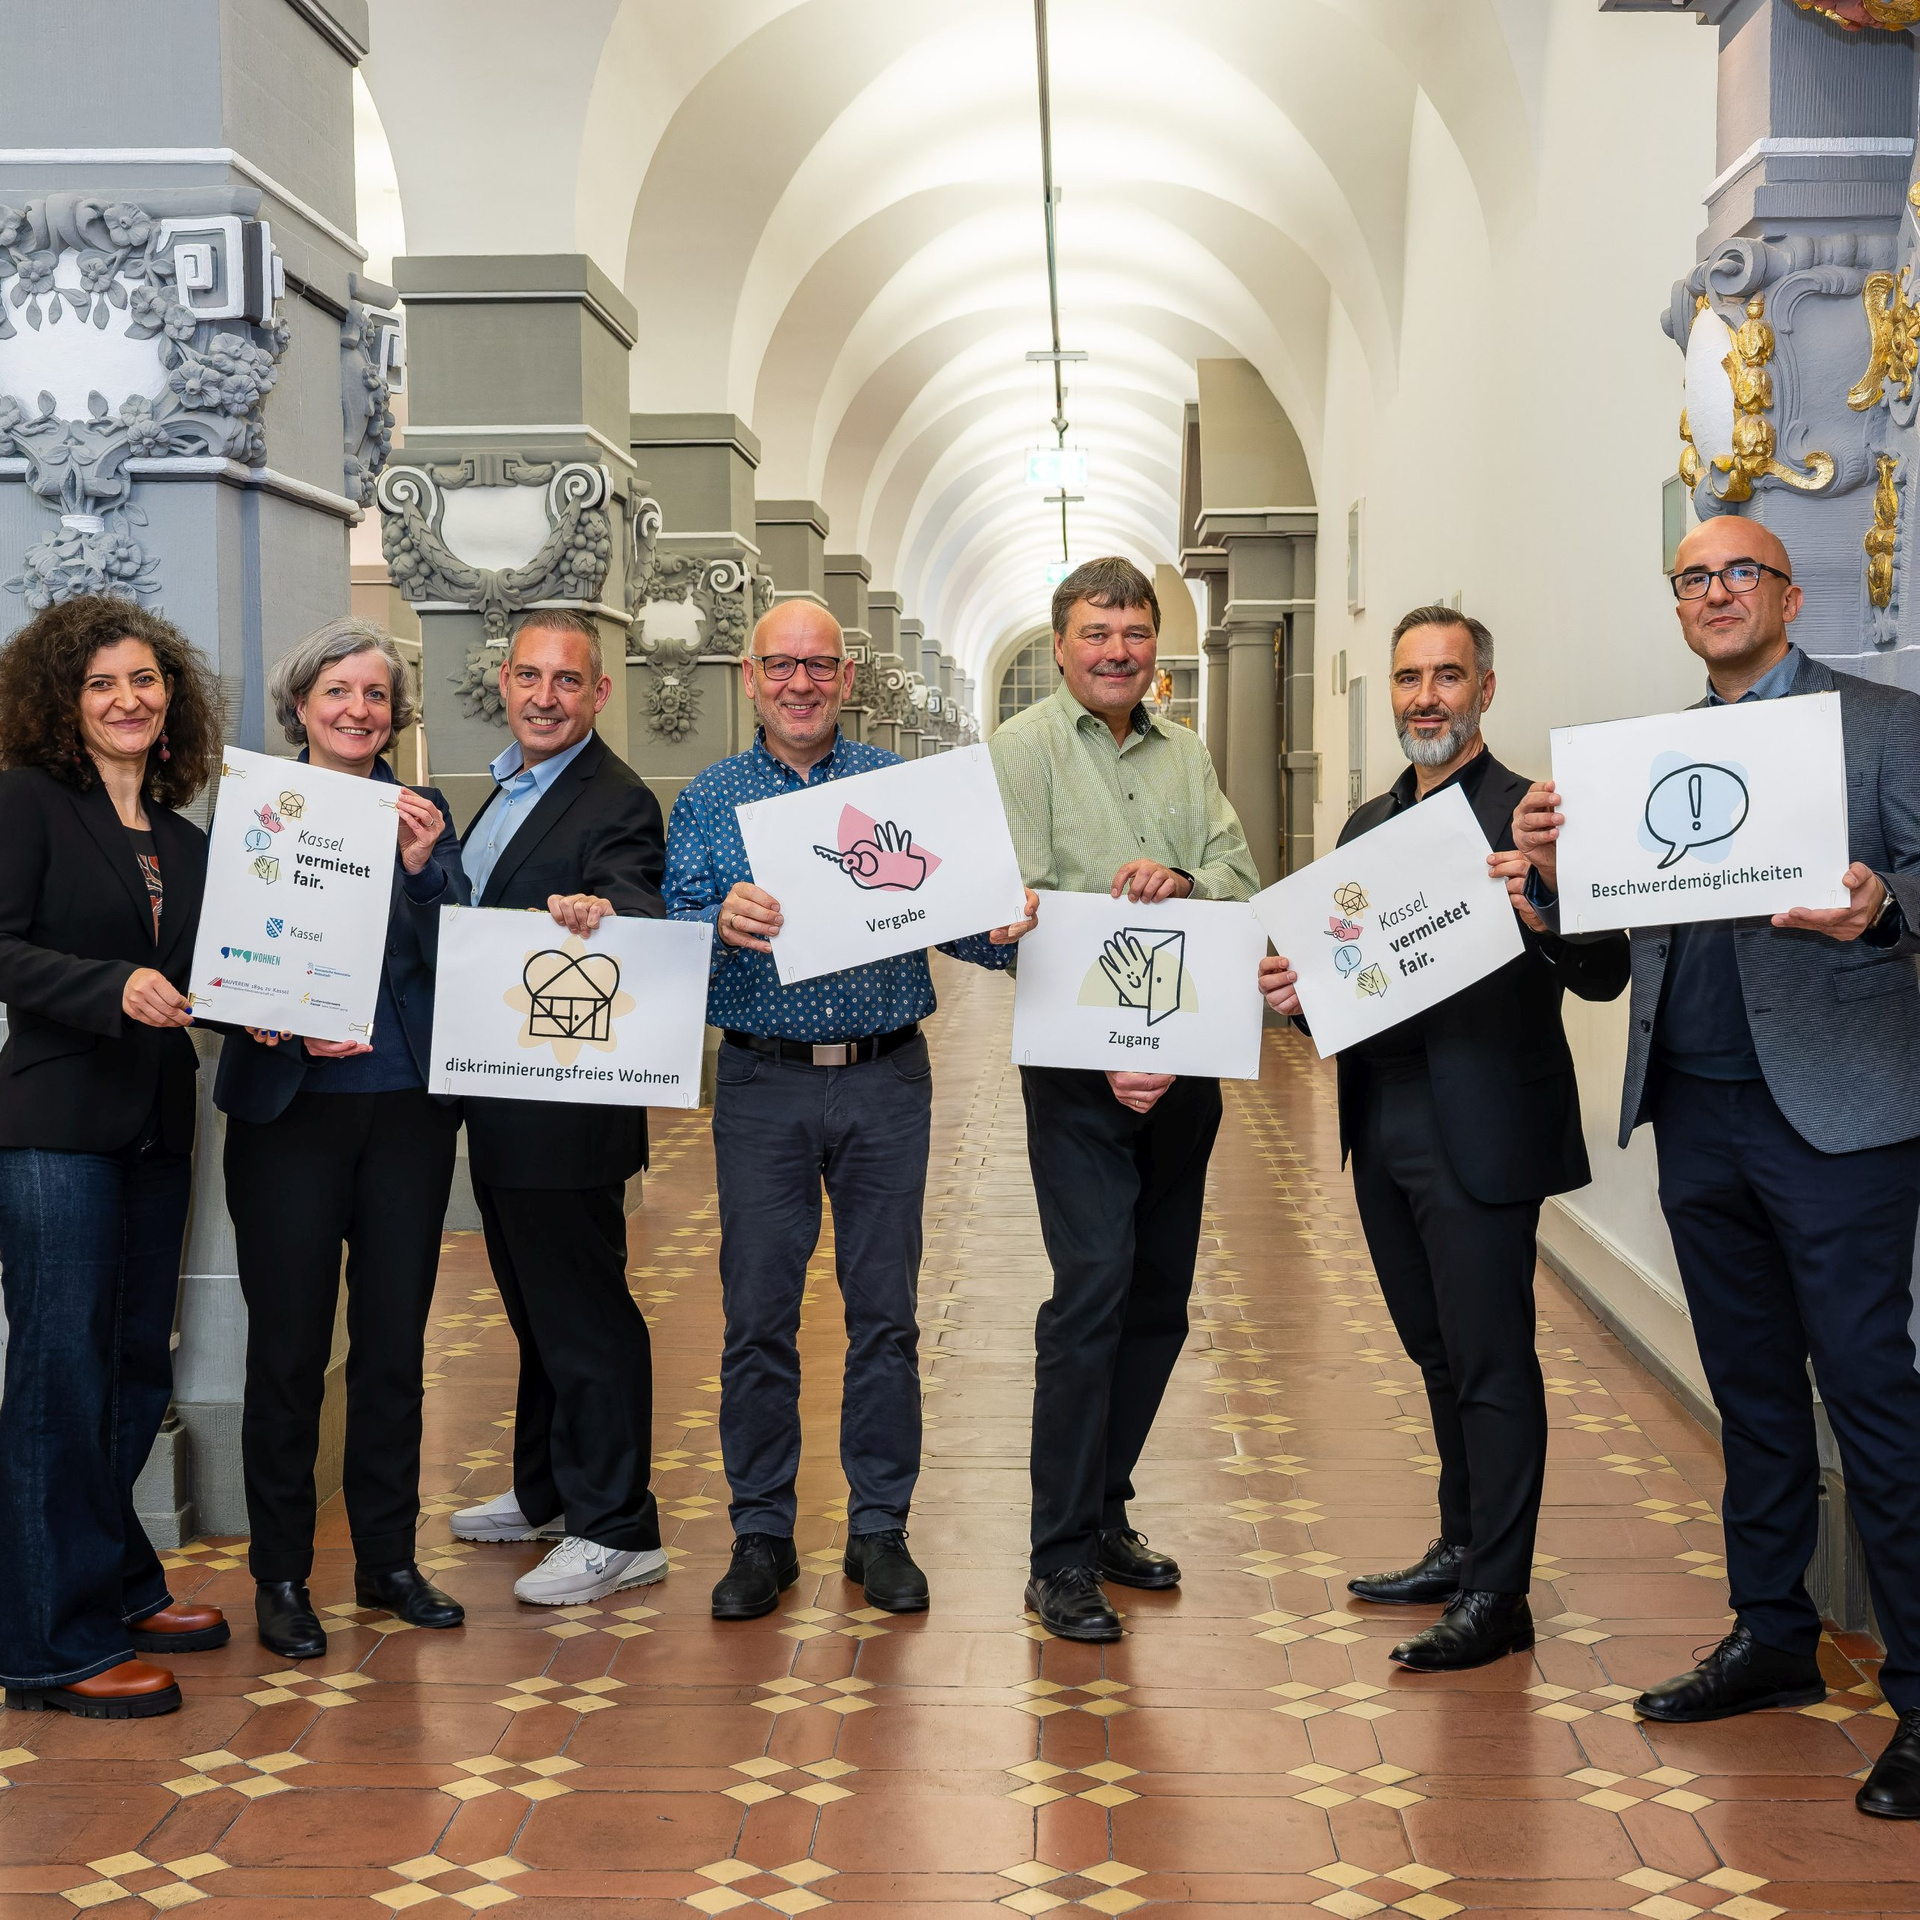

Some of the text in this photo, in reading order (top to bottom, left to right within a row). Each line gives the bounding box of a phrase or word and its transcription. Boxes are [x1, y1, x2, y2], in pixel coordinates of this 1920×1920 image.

[297, 829, 345, 852] Kassel
[296, 853, 371, 878] vermietet
[293, 870, 324, 890] fair.
[1591, 865, 1803, 898] Beschwerdemöglichkeiten
[865, 908, 926, 932] Vergabe
[1378, 891, 1428, 931] Kassel
[290, 926, 323, 943] Kassel
[1389, 900, 1471, 953] vermietet
[252, 951, 281, 966] WOHNEN
[1398, 952, 1435, 977] fair.
[1108, 1031, 1160, 1049] Zugang
[445, 1057, 680, 1084] diskriminierungsfreies Wohnen
